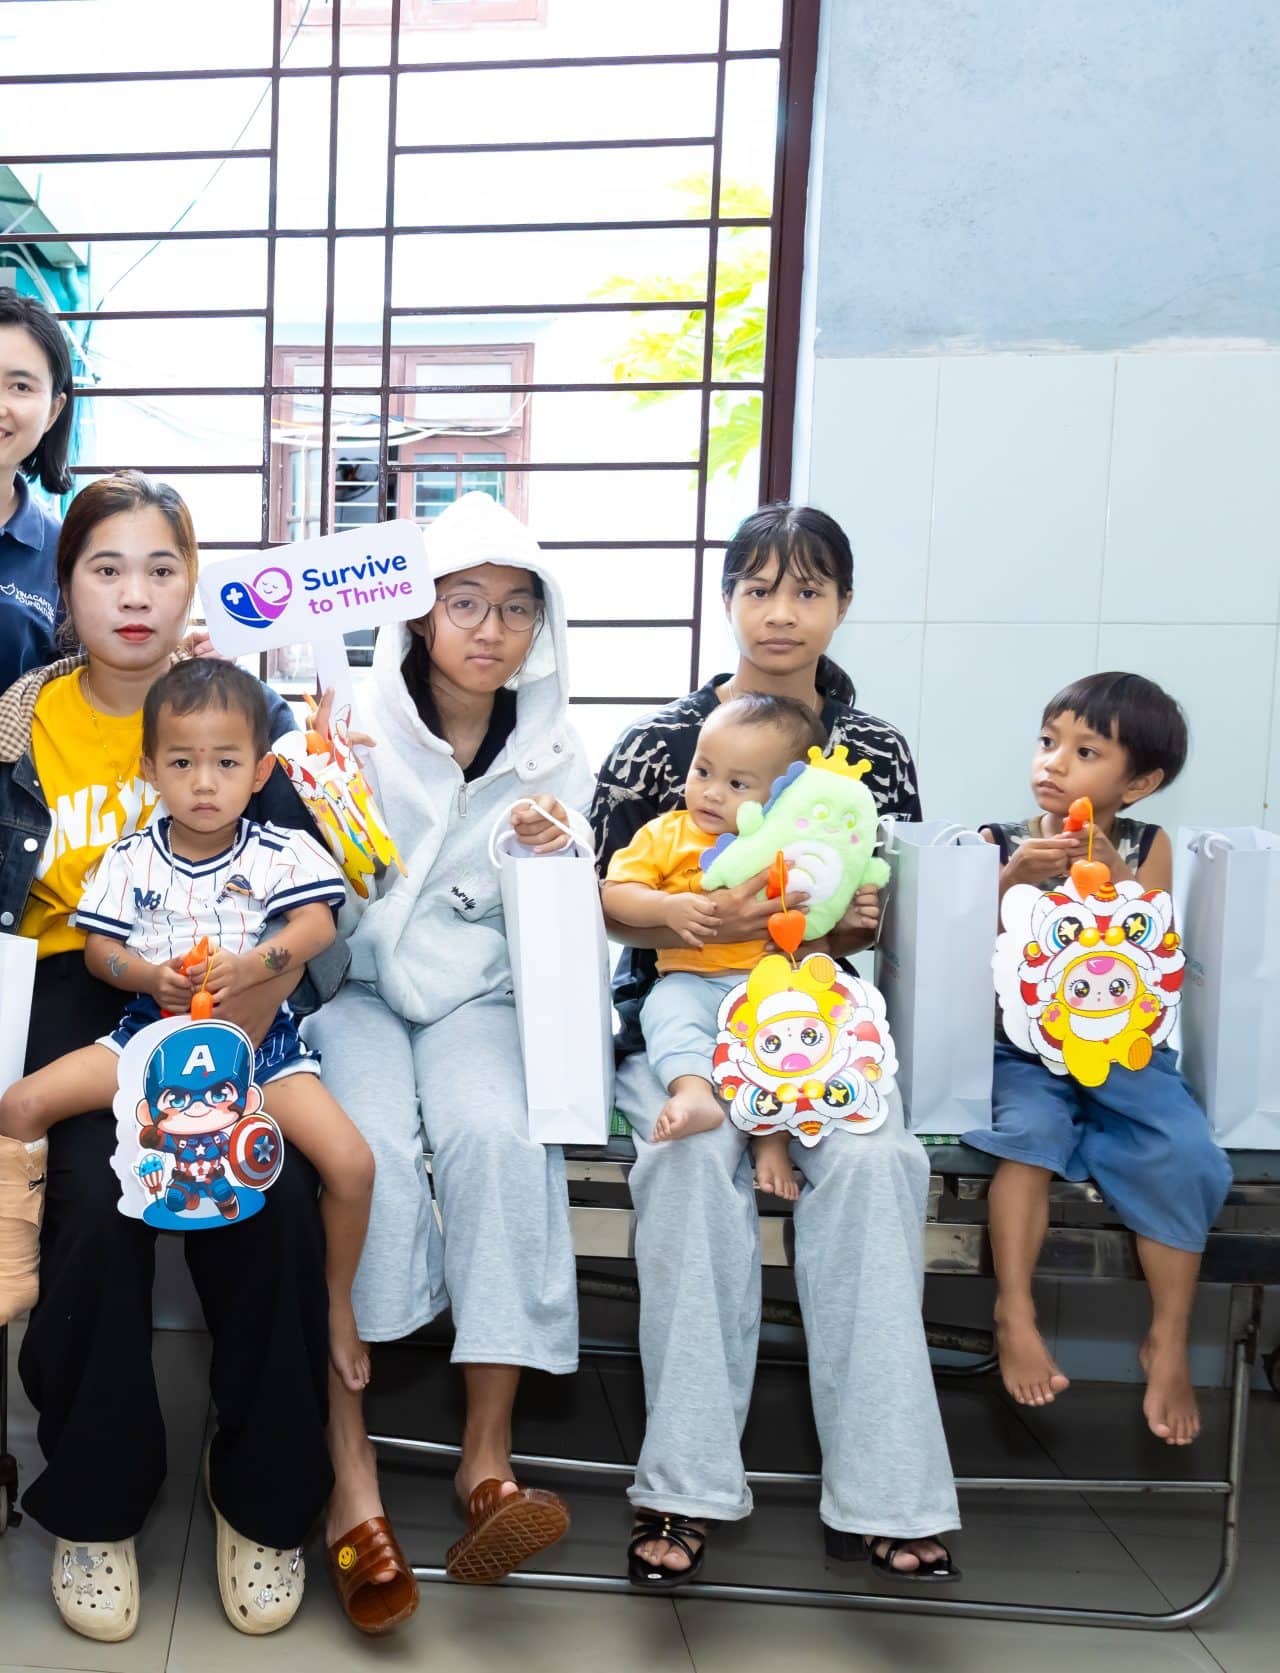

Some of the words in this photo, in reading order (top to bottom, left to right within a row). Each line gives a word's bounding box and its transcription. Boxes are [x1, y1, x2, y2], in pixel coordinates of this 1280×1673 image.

[302, 555, 407, 591] Survive
[308, 599, 333, 614] to
[336, 581, 413, 608] Thrive
[181, 1045, 216, 1075] A
